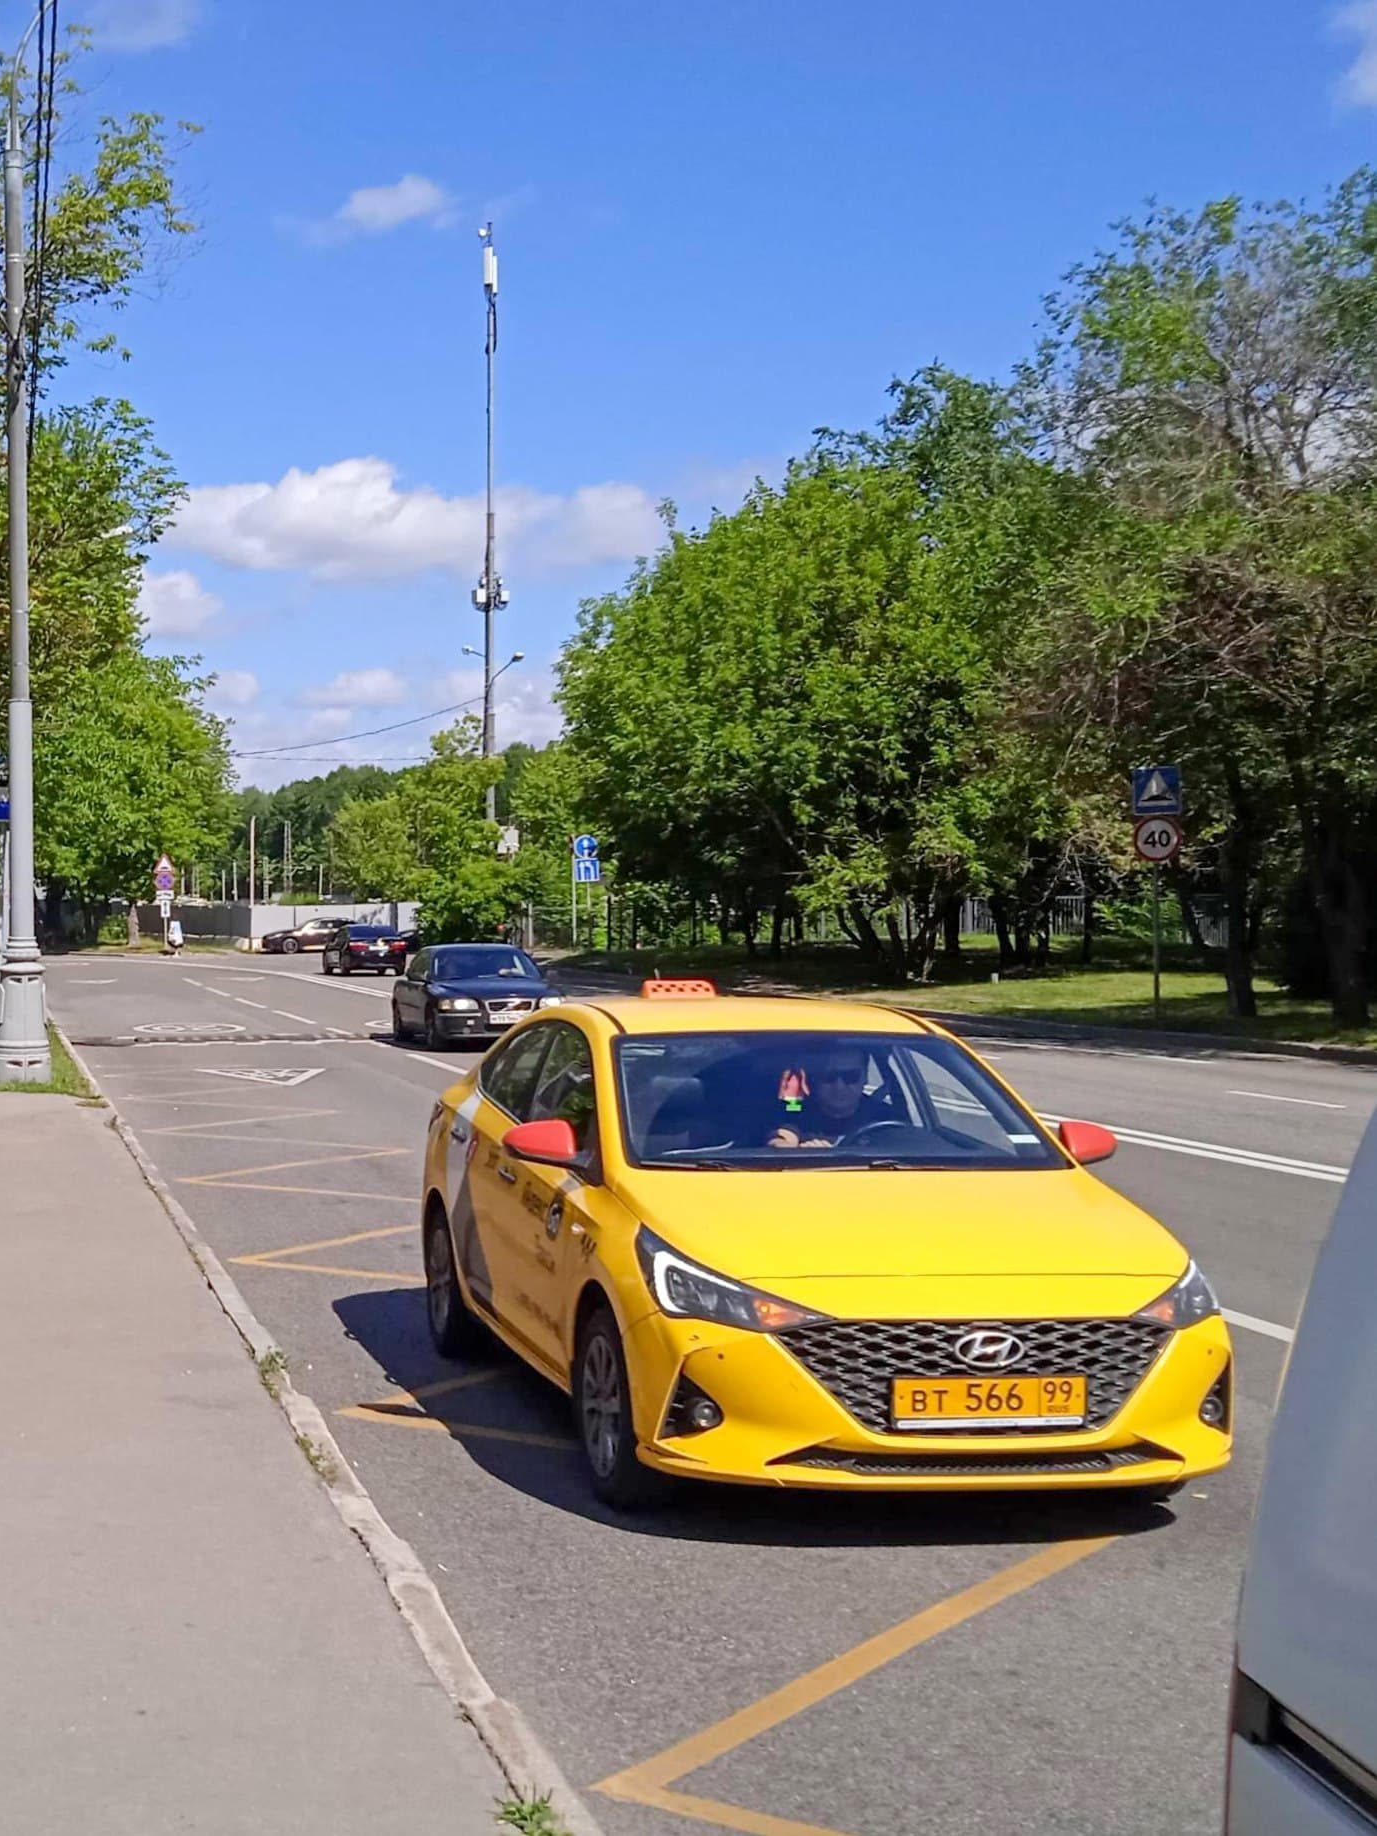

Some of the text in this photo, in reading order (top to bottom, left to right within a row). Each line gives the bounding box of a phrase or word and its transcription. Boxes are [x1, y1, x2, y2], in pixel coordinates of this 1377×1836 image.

[1143, 830, 1171, 848] 40
[911, 1381, 1072, 1413] ВТ 566 99
[1047, 1404, 1069, 1414] RUS
